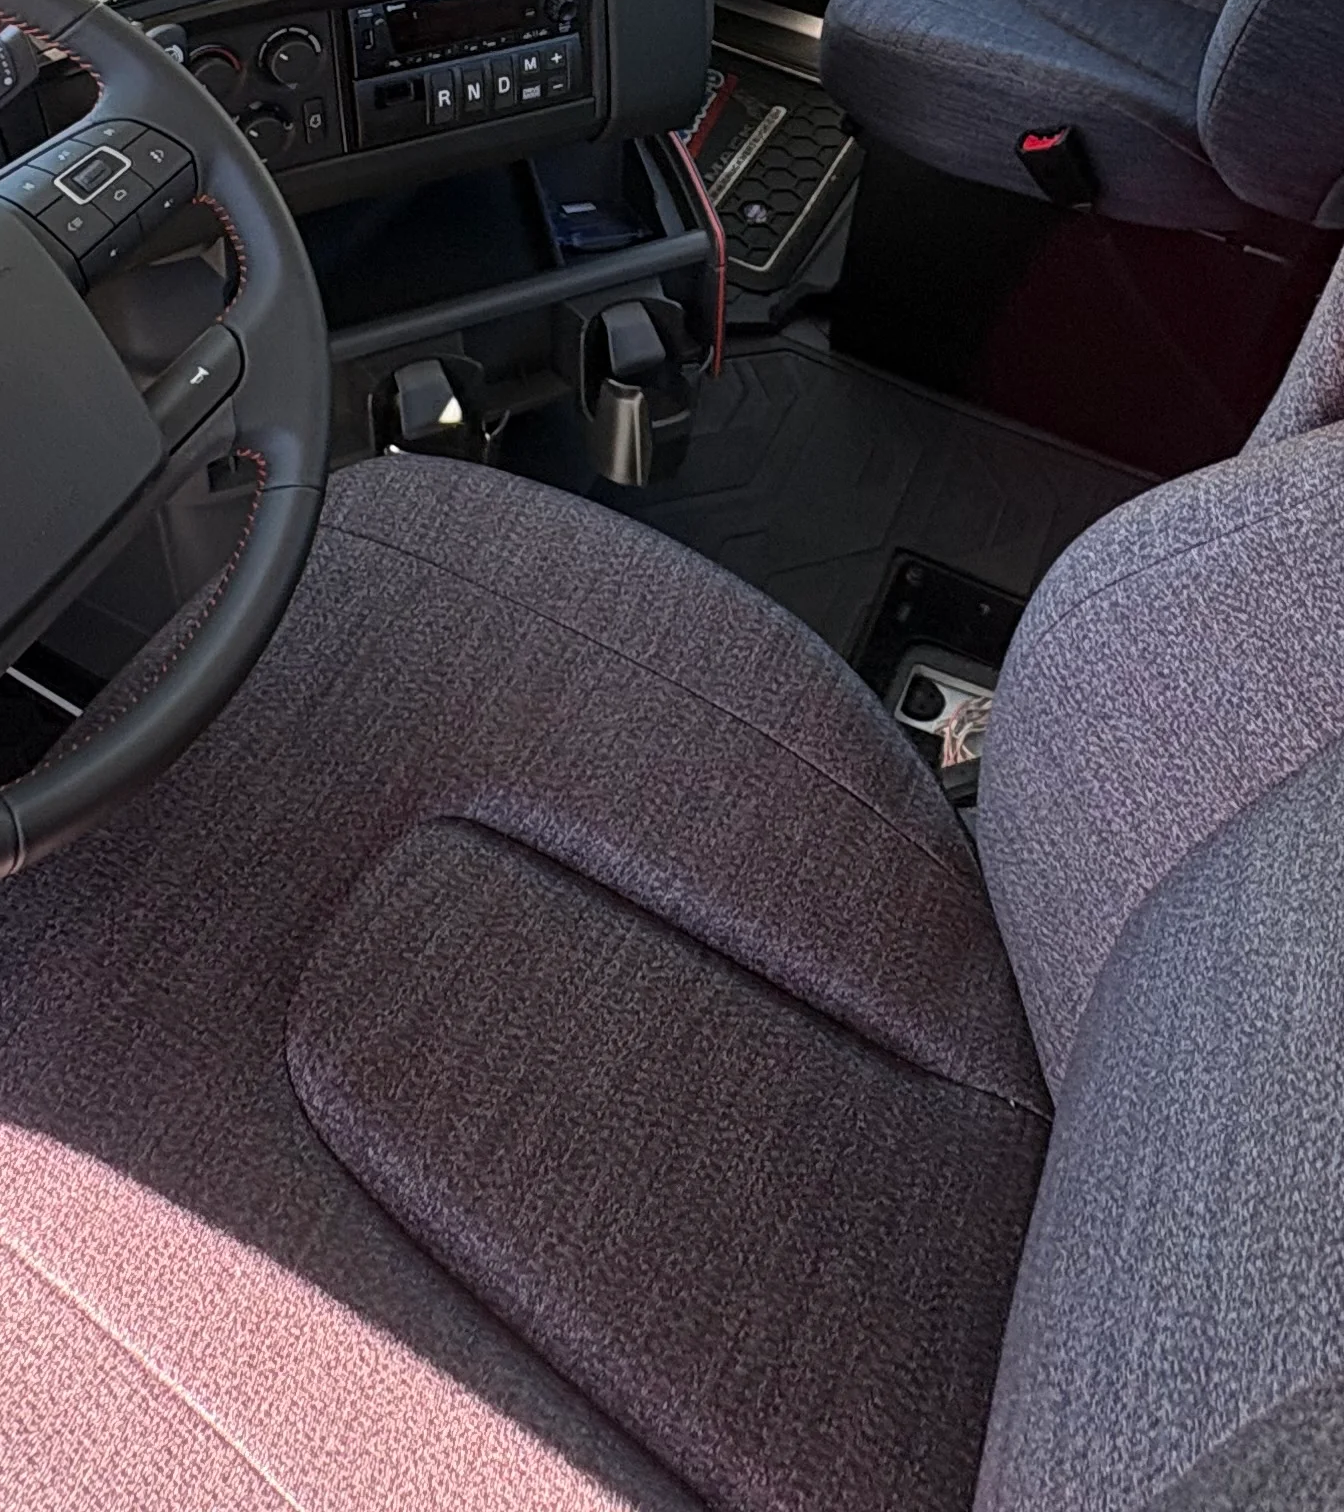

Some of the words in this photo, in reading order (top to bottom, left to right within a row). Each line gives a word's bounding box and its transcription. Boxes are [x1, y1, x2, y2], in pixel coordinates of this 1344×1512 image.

[524, 56, 538, 72] M
[467, 82, 481, 101] N
[498, 76, 511, 94] D
[438, 89, 452, 108] R
